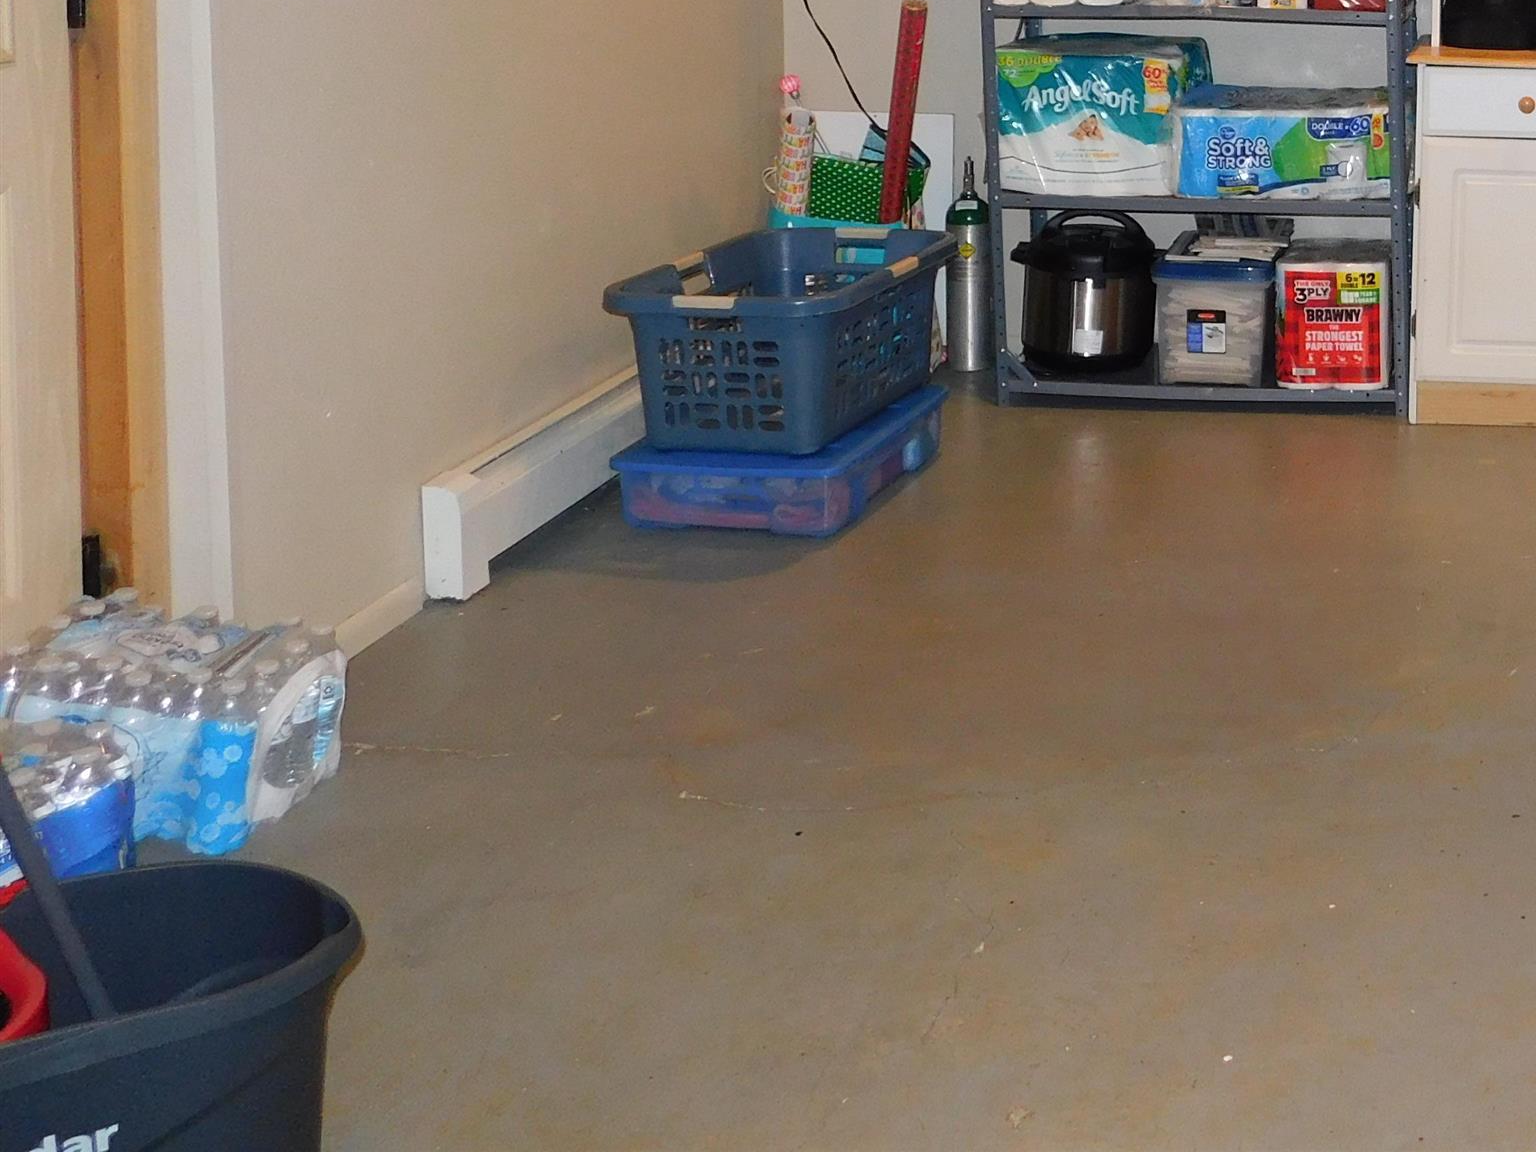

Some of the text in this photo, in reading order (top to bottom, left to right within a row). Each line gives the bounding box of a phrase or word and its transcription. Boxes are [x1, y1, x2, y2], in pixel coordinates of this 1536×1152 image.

[1022, 79, 1140, 116] Angel Soft
[1350, 117, 1370, 134] 60
[1206, 156, 1273, 170] STRONG
[1305, 308, 1362, 323] BRAWNY
[1305, 330, 1364, 342] STRONGEST
[1305, 342, 1364, 352] PAPER TOWEL
